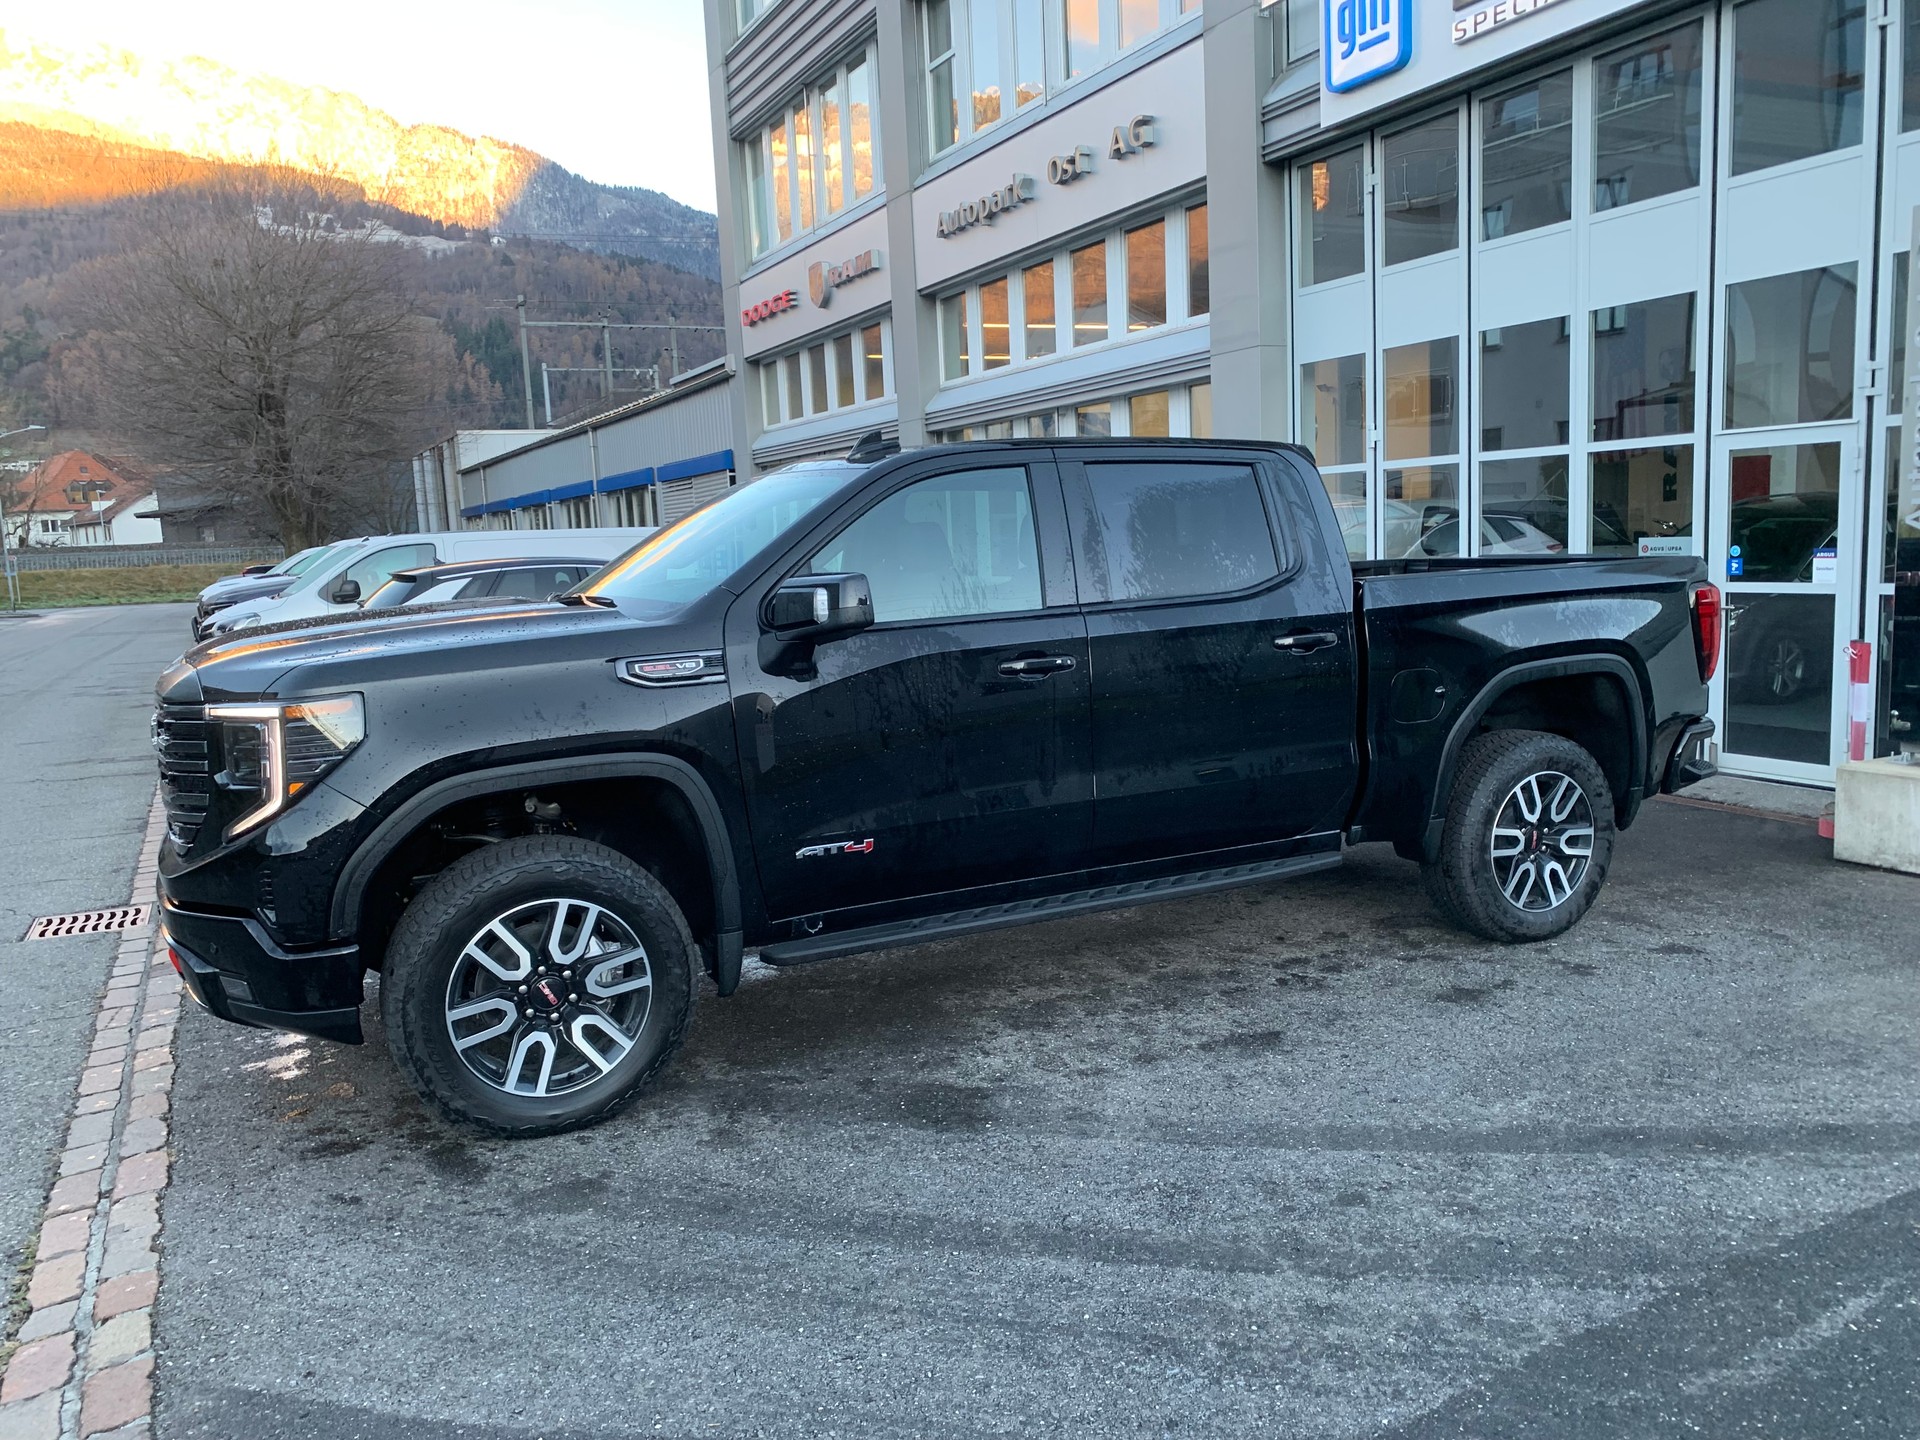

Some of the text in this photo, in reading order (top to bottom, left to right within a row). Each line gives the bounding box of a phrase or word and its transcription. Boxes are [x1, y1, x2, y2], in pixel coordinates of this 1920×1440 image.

[1454, 0, 1548, 41] SPEC
[936, 114, 1155, 239] Autopark Ost AG
[828, 249, 879, 288] RAM
[742, 289, 798, 327] DODGE
[795, 838, 874, 859] AT4
